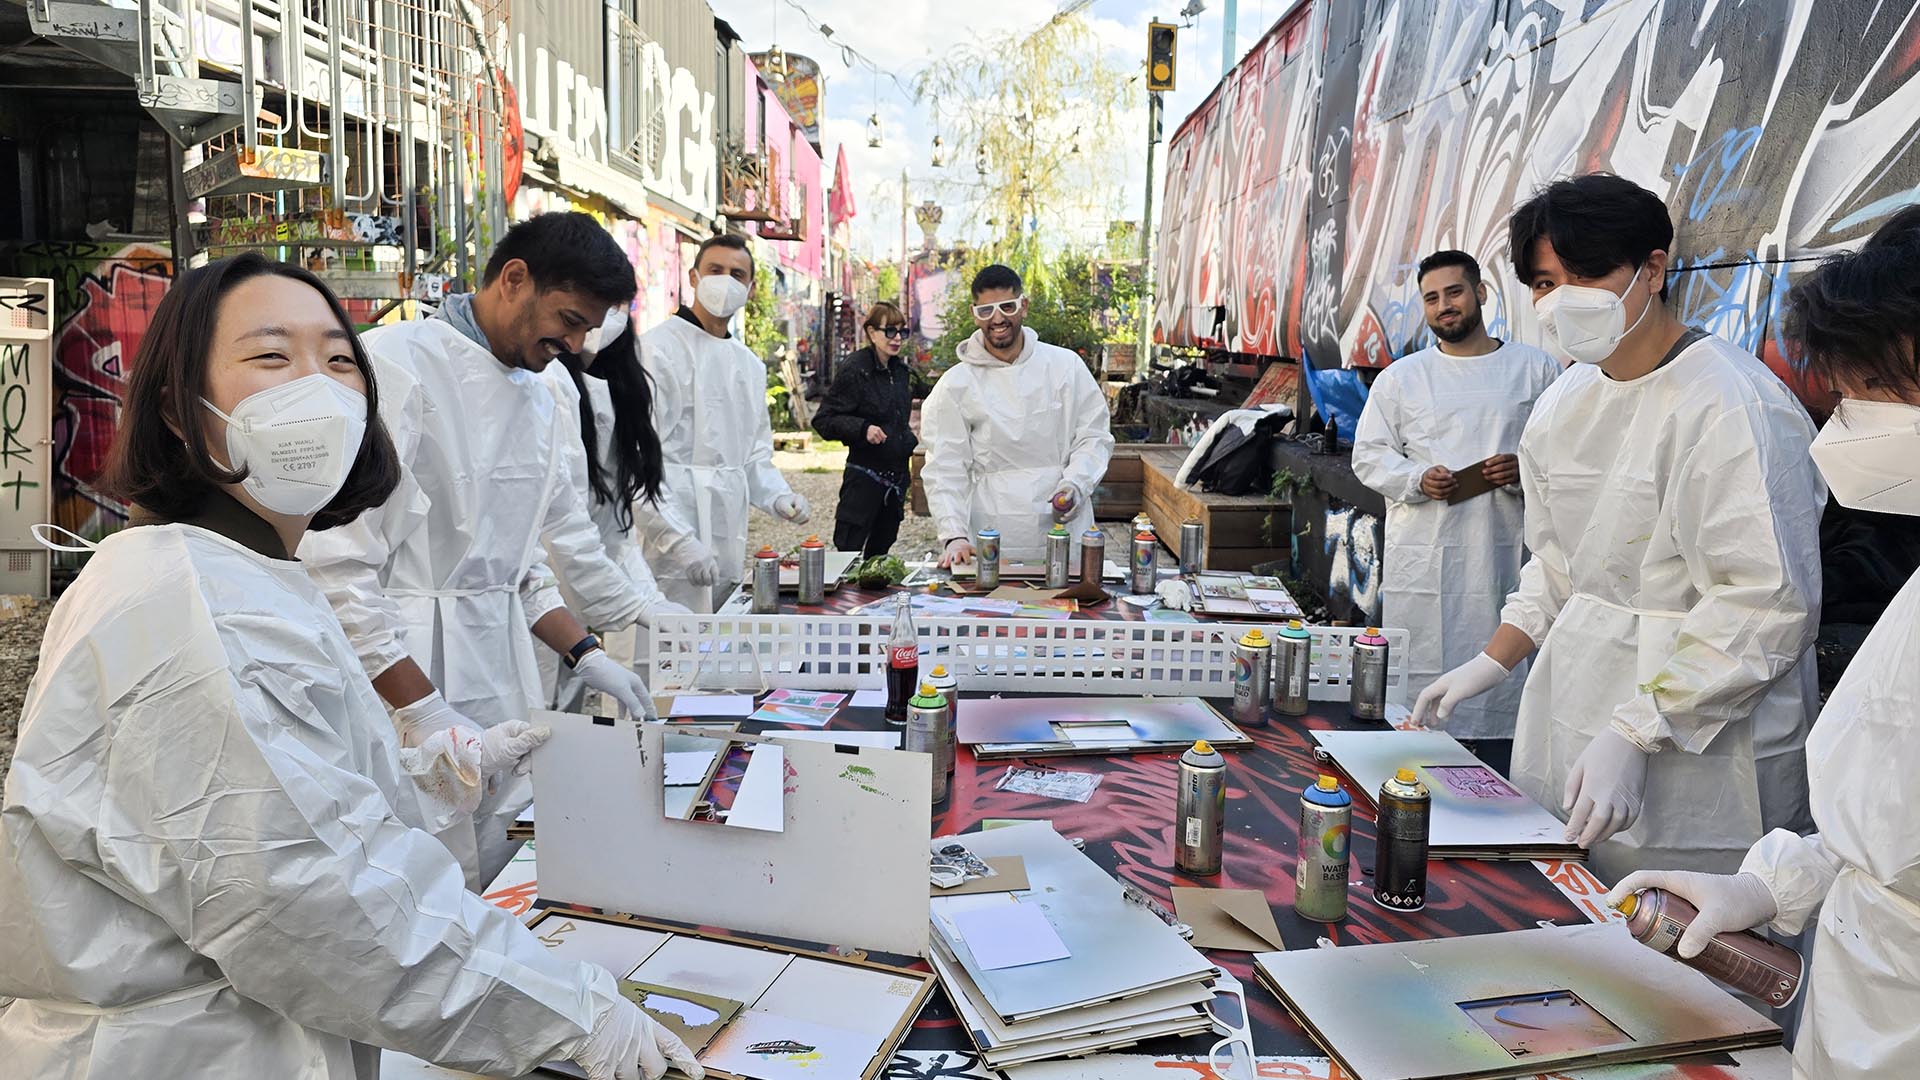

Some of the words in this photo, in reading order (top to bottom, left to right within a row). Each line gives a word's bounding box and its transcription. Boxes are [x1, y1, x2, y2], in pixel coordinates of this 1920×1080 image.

[508, 32, 608, 167] LLERY
[296, 461, 317, 471] 2797
[1321, 864, 1349, 873] WATE
[1322, 872, 1347, 881] BASE
